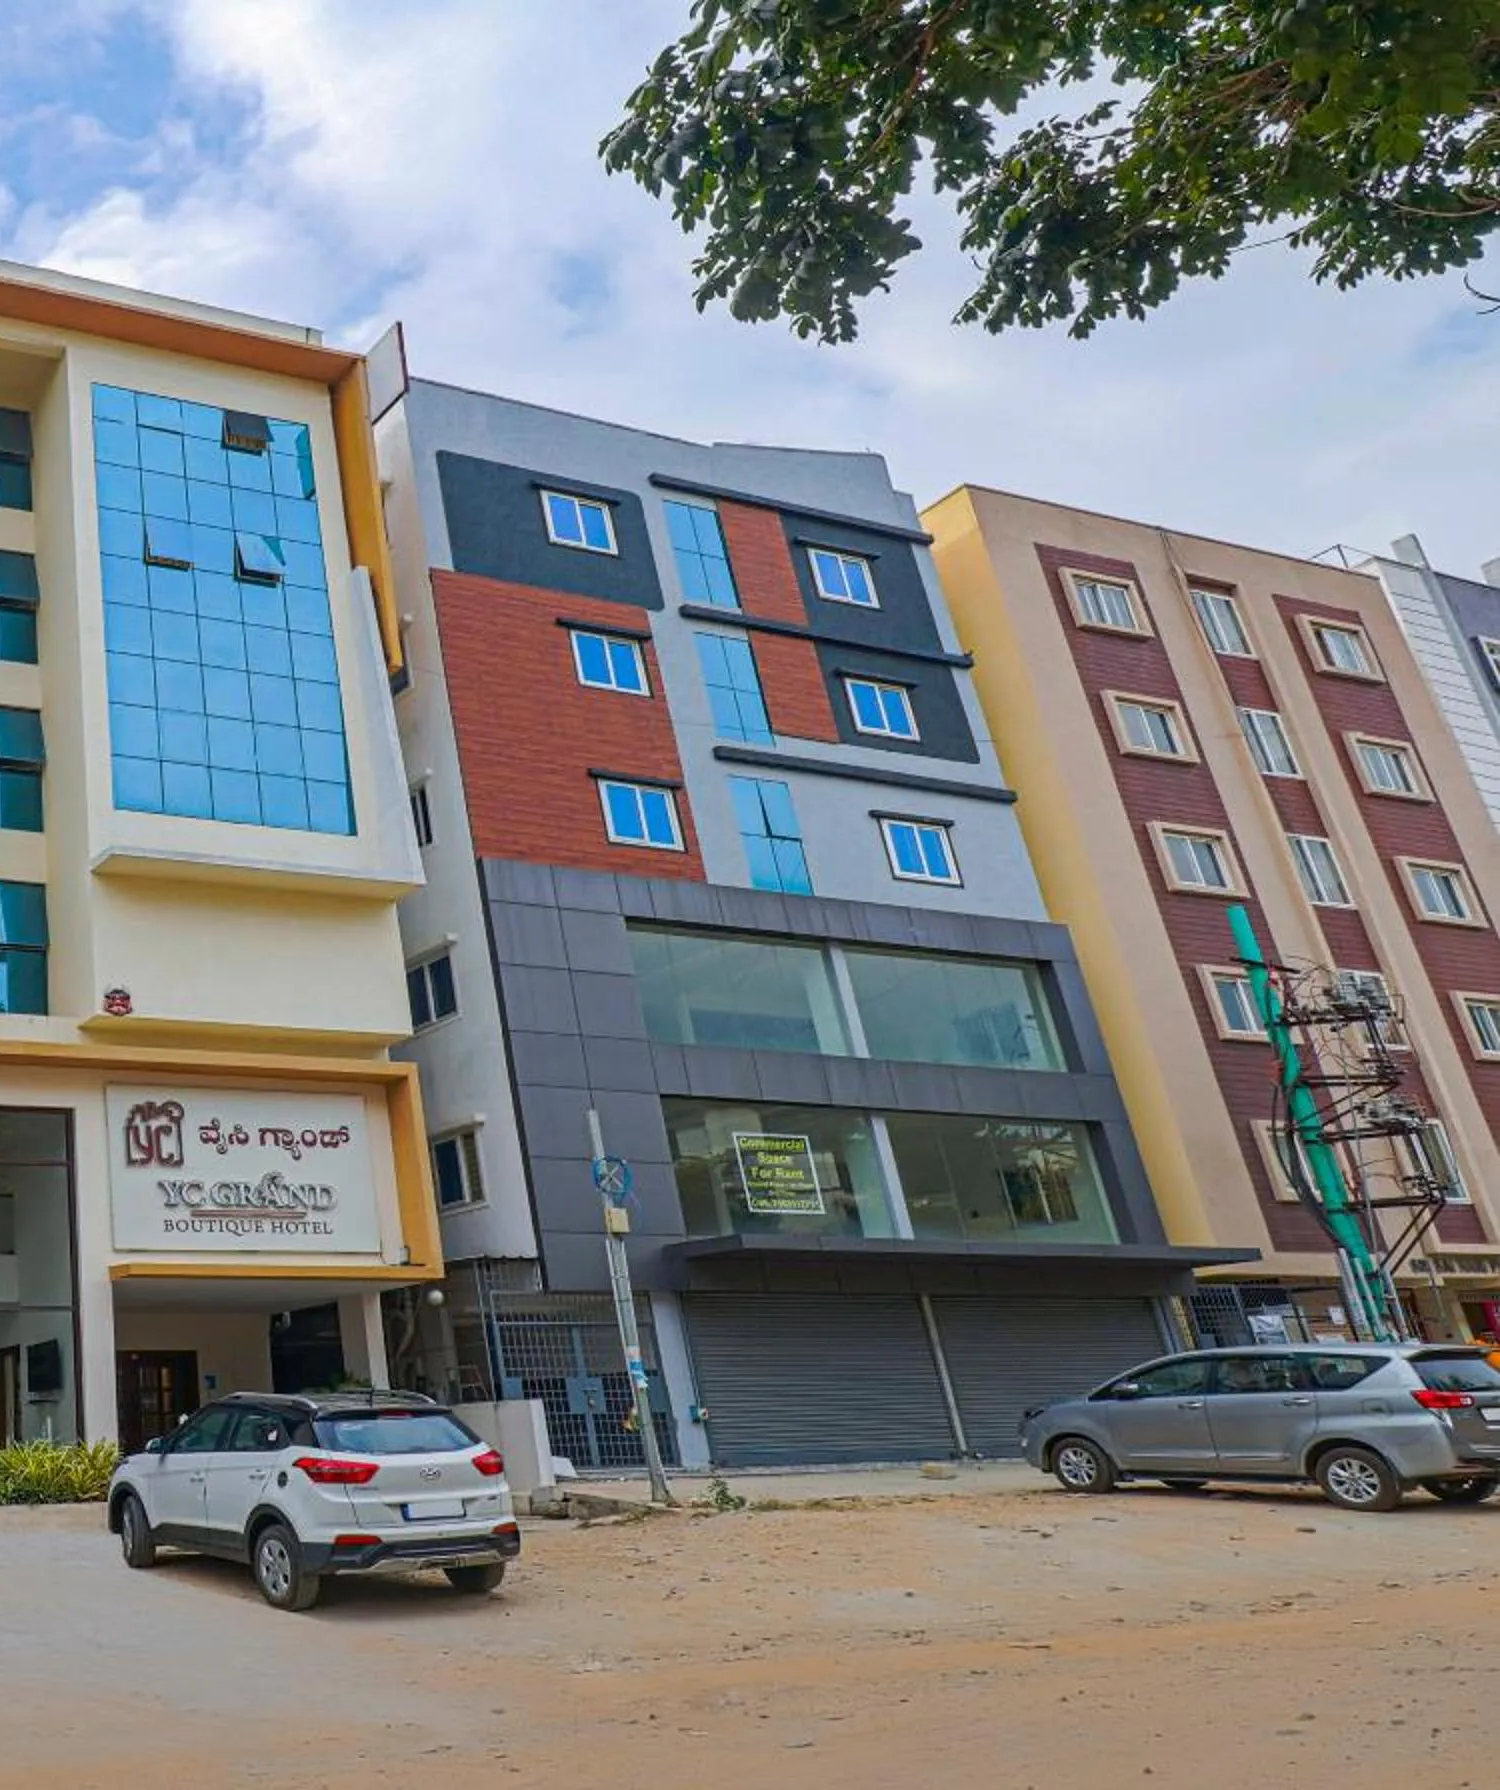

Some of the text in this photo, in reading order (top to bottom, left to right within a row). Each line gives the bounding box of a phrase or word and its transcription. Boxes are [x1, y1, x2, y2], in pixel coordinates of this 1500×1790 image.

[739, 1137, 805, 1151] Commercial
[751, 1166, 773, 1178] For
[163, 1218, 334, 1237] BOUTIQUE HOTEL
